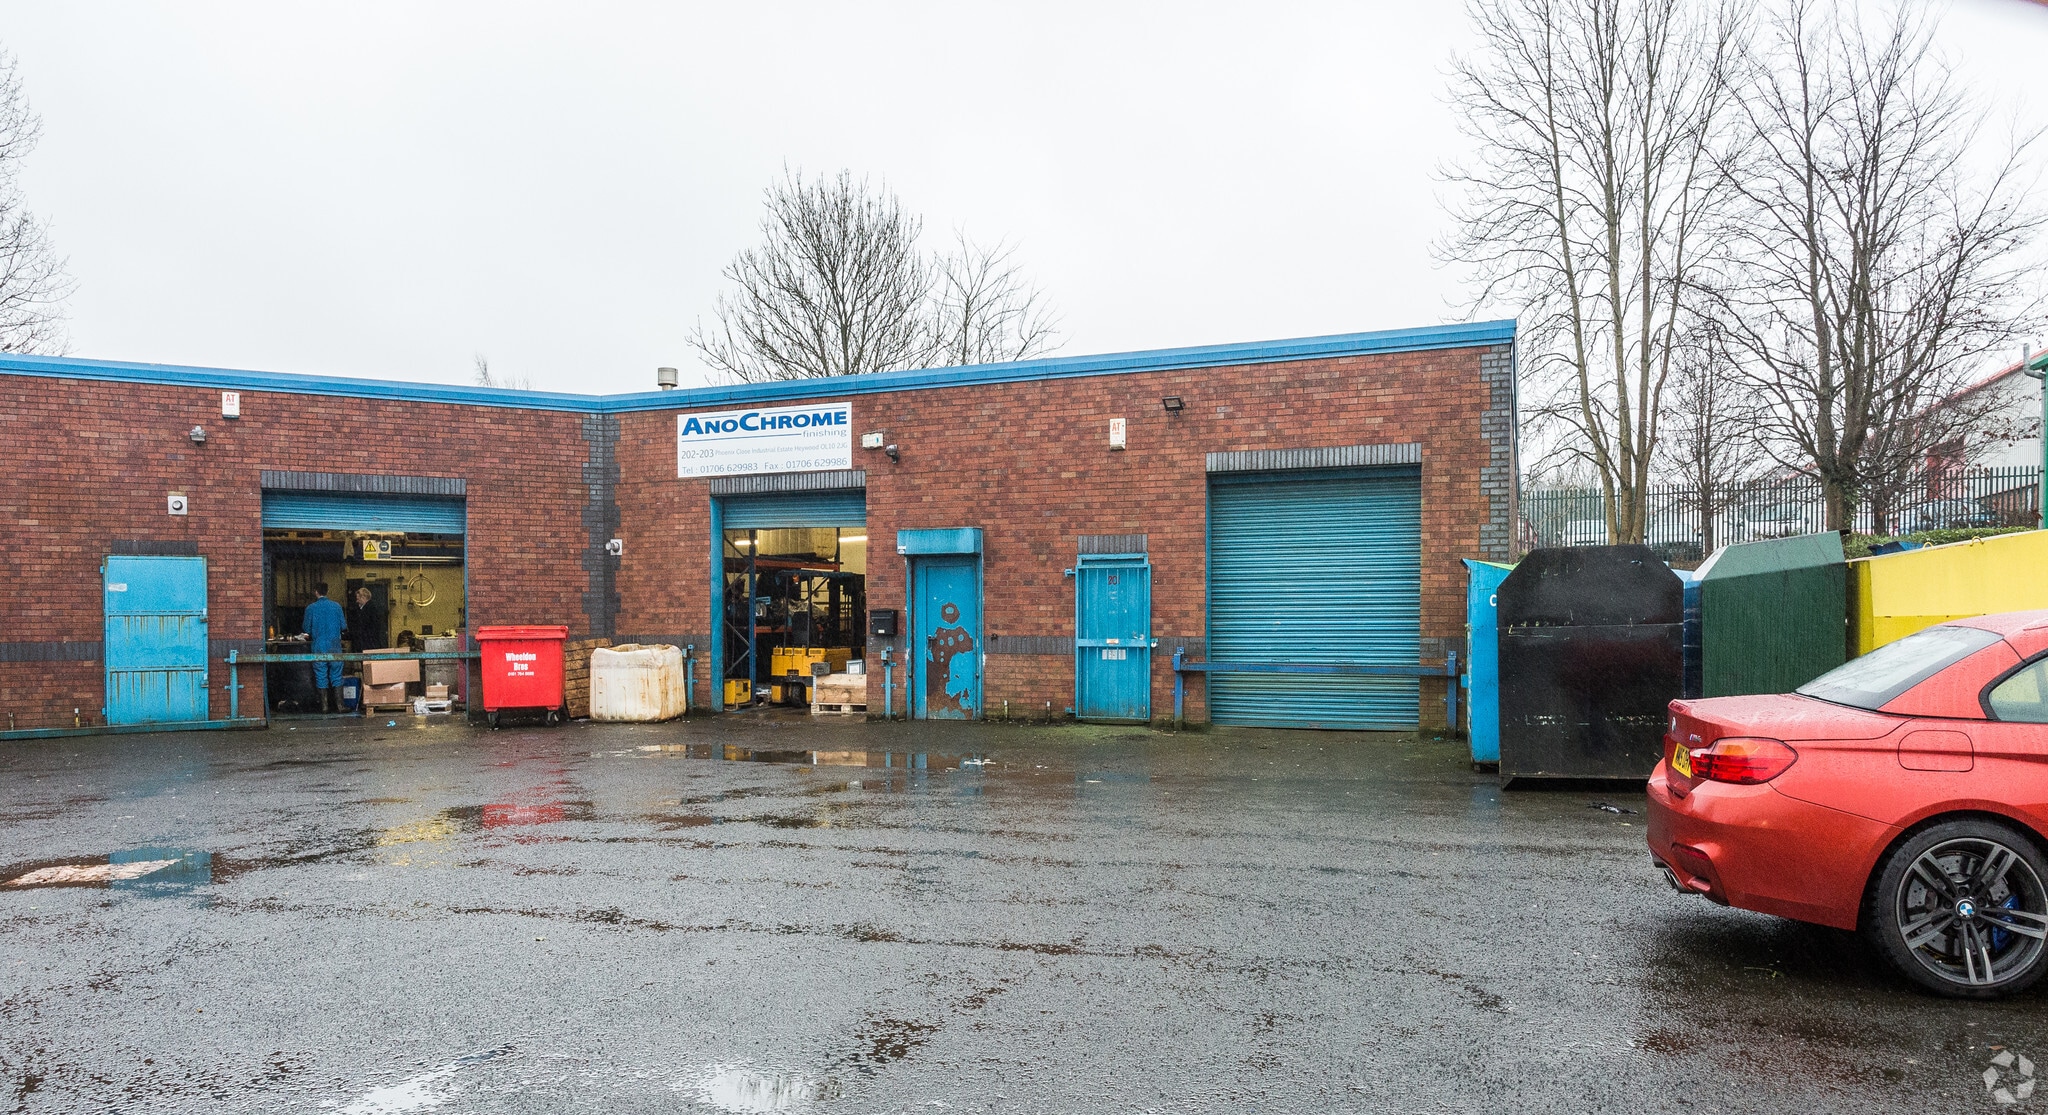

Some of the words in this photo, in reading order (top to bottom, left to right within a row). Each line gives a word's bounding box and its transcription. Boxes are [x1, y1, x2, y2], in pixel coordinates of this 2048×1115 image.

[803, 429, 847, 437] finishing
[681, 449, 714, 459] 202-203
[700, 465, 725, 473] 01706
[726, 463, 758, 472] 629983
[764, 462, 779, 470] Fax
[785, 460, 812, 469] 01706
[814, 458, 847, 467] 629986
[506, 652, 536, 662] Wheeldon
[514, 662, 528, 670] Bros
